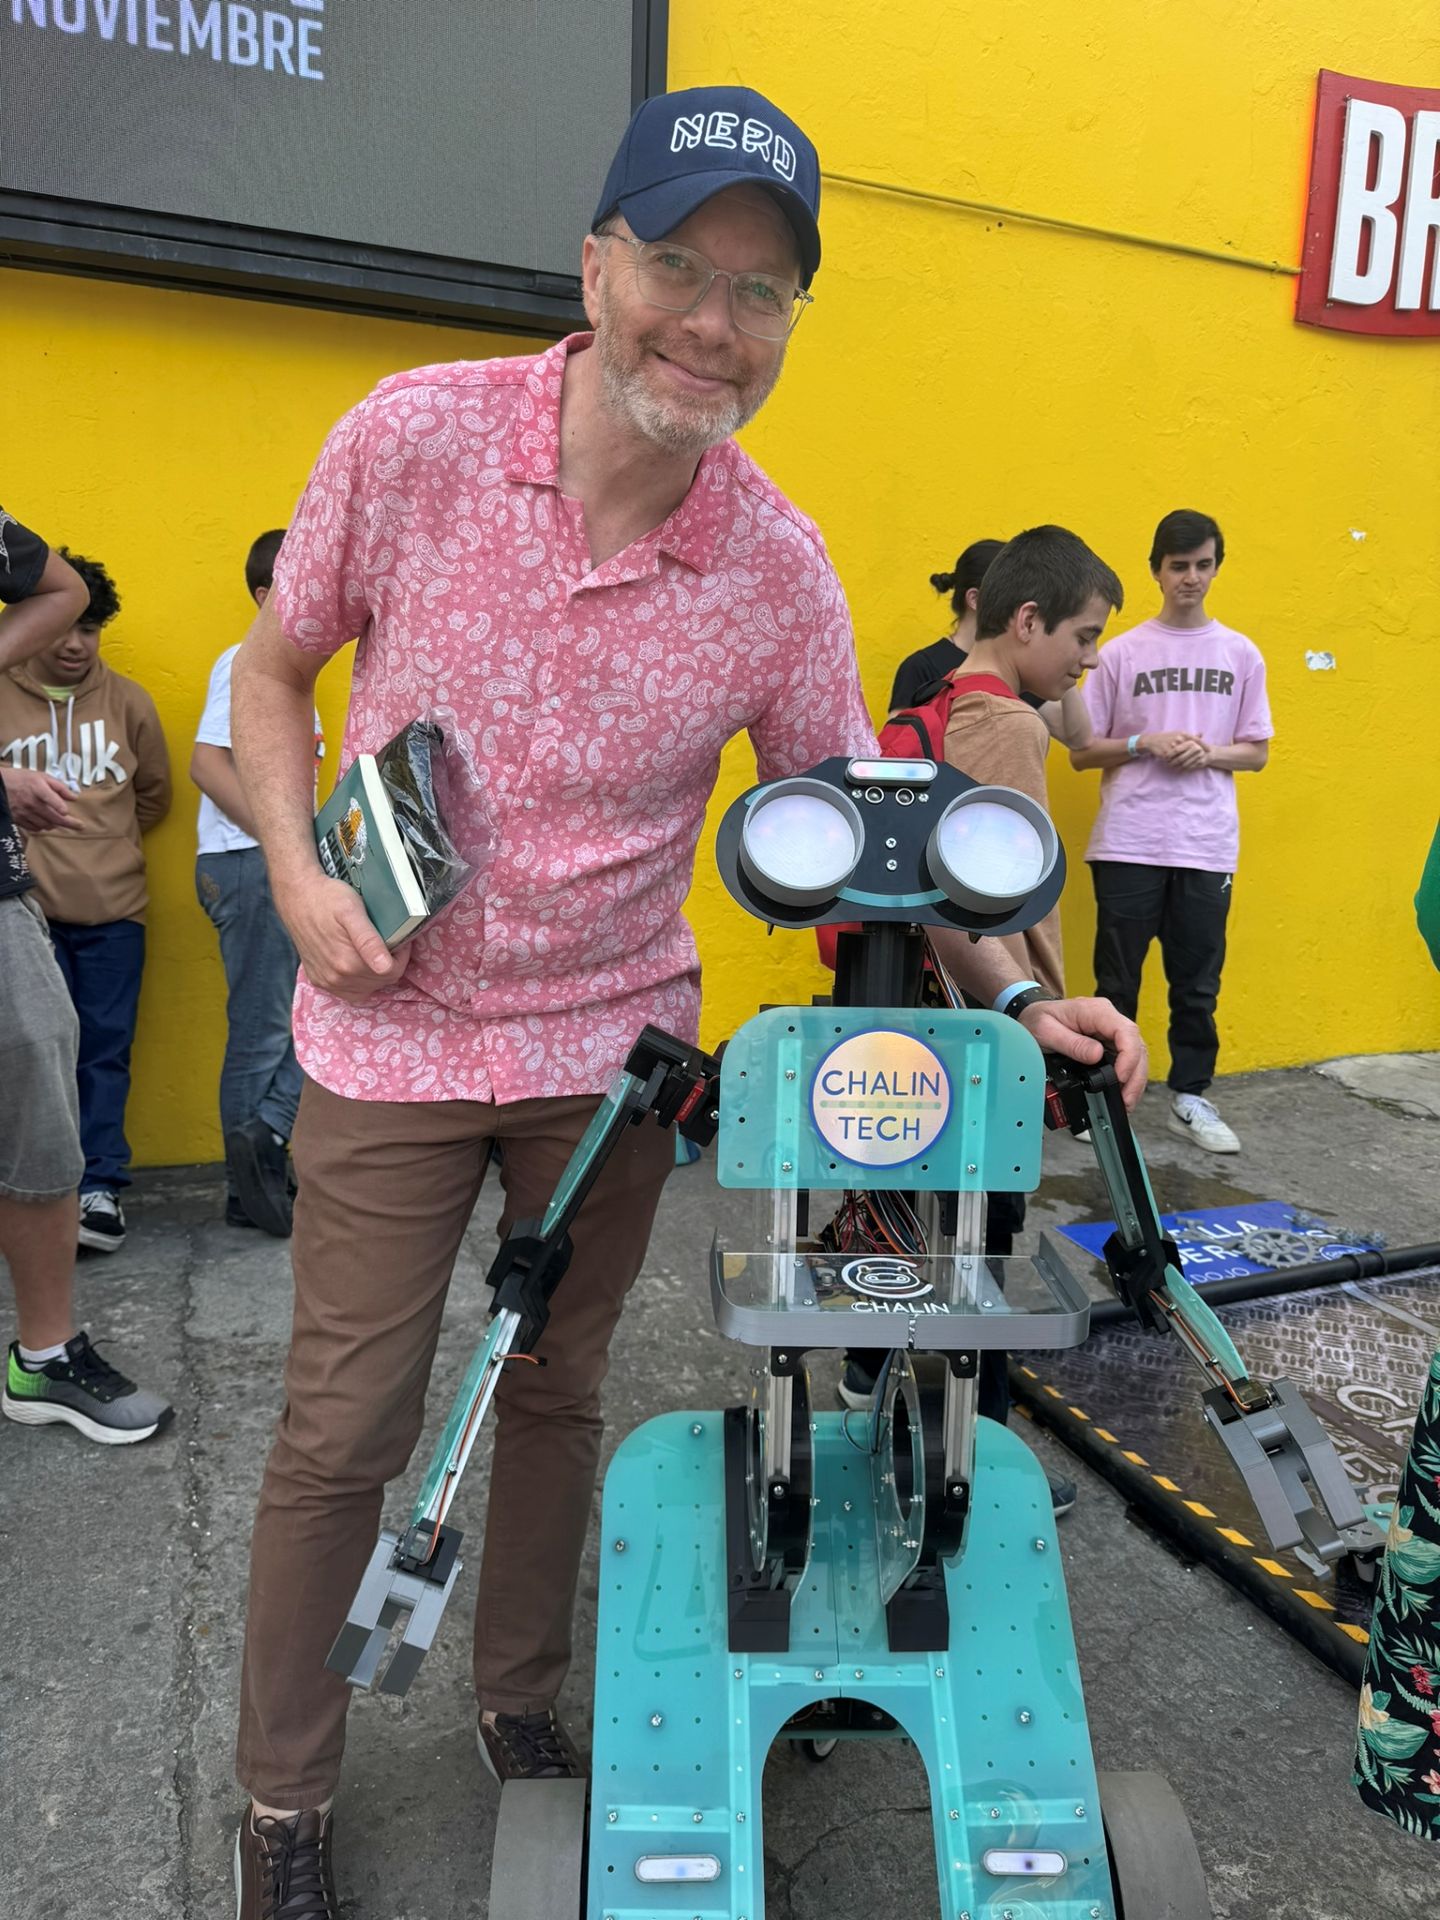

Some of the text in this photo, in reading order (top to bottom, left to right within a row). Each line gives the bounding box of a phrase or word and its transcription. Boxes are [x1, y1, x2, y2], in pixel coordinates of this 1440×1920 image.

[670, 111, 796, 181] NERD
[1133, 667, 1235, 697] ATELIER
[821, 1070, 940, 1096] CHALIN
[838, 1116, 920, 1141] TECH
[851, 1301, 950, 1314] CHALIN
